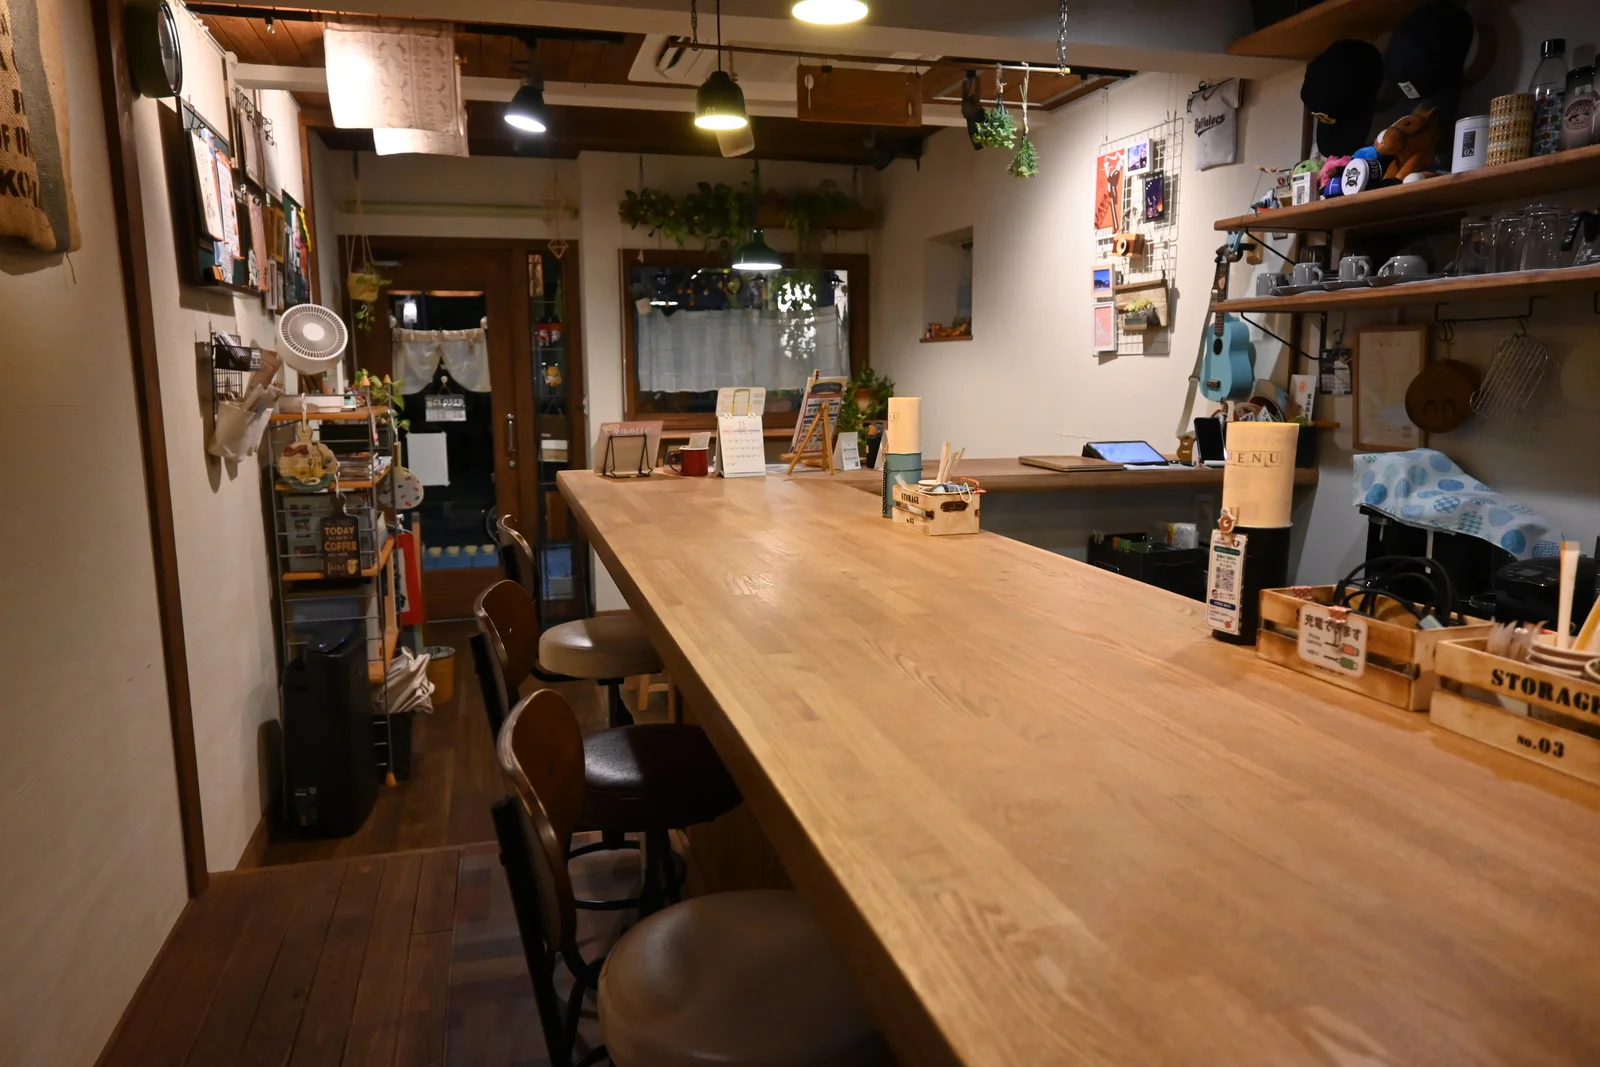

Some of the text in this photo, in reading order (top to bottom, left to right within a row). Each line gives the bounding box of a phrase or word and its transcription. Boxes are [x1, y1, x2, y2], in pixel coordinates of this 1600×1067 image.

[1464, 148, 1475, 156] 02
[1228, 452, 1279, 464] ENU
[900, 492, 919, 505] STORAGE
[324, 526, 354, 536] TODAY
[324, 541, 357, 551] COFFEE
